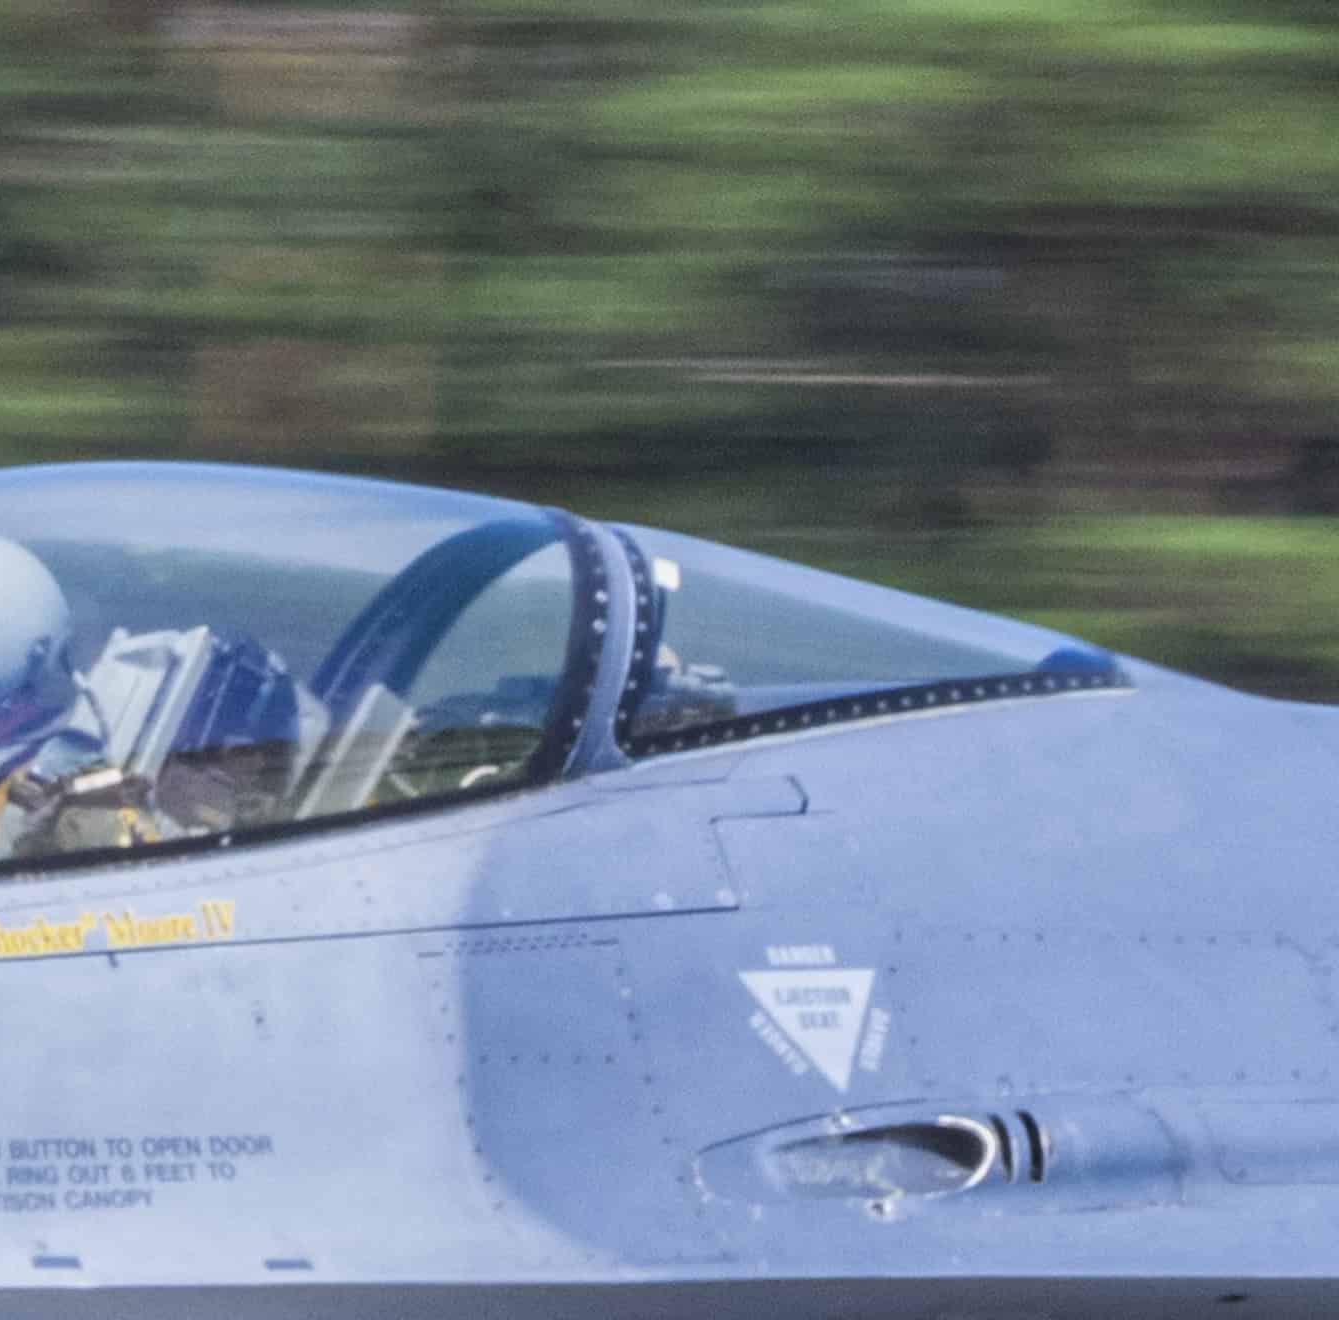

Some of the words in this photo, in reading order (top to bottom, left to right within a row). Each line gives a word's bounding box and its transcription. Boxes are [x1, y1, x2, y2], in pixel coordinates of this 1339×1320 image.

[201, 902, 234, 938] IV
[8, 1137, 96, 1160] BUTTON
[104, 1136, 133, 1158] TO
[141, 1135, 202, 1158] OPEN
[209, 1134, 274, 1156] DOOR
[6, 1164, 60, 1187] RING
[67, 1163, 112, 1185] OUT
[143, 1161, 198, 1183] FEET
[208, 1160, 237, 1182] TO
[64, 1189, 154, 1211] CANOPY
